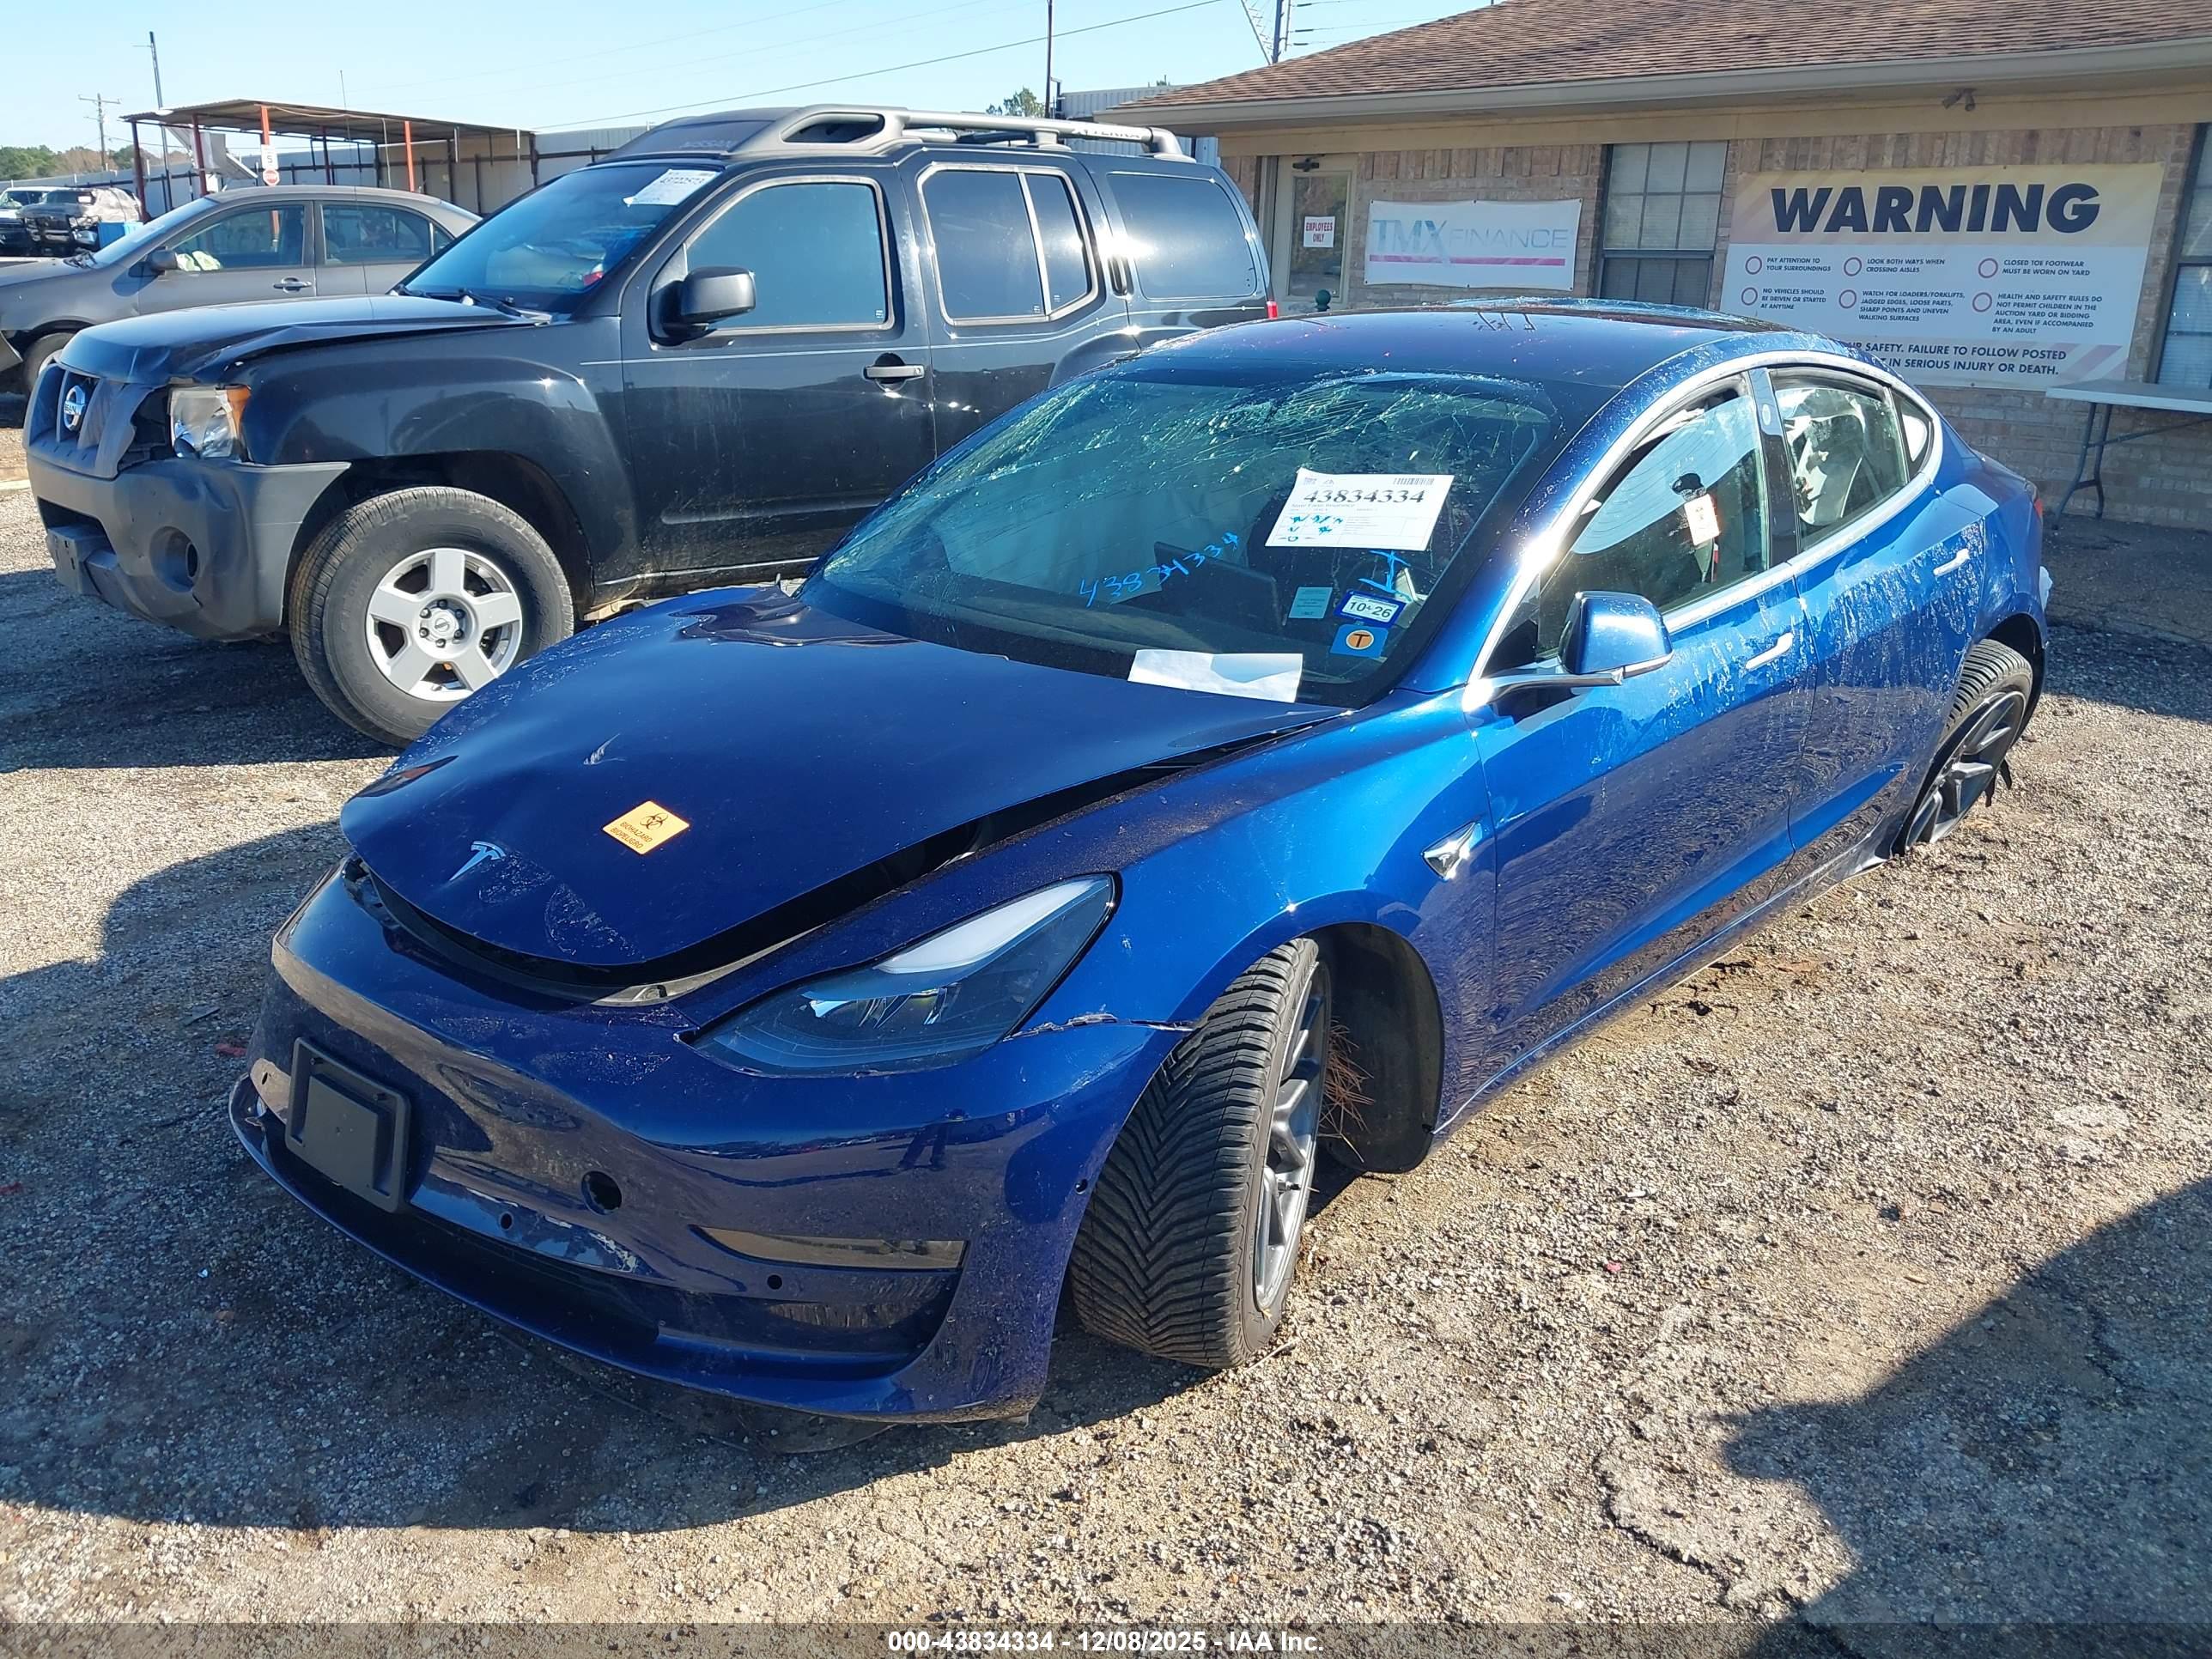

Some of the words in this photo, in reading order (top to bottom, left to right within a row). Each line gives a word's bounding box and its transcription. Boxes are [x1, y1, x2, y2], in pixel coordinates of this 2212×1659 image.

[1771, 183, 2101, 234] WARNING
[1305, 222, 1333, 232] EMPLOYEES
[1313, 233, 1325, 242] ONLY
[1372, 220, 1449, 260] TMX
[1449, 228, 1570, 249] FINANCE
[1865, 343, 1905, 353] SAFETY.
[1908, 344, 1949, 355] FAILURE
[1953, 346, 1968, 356] TO
[1971, 347, 2019, 358] FOLLOW
[2021, 349, 2067, 360] POSTED
[1888, 357, 1901, 368] IN
[1904, 358, 1950, 369] SERIOUS
[1953, 361, 1996, 372] INJURY
[1997, 362, 2015, 373] OR
[2018, 364, 2059, 375] DEATH.
[1304, 489, 1426, 503] 43834334
[610, 827, 643, 849] BIOPELIGRO
[620, 821, 653, 843] BIOHAZARD
